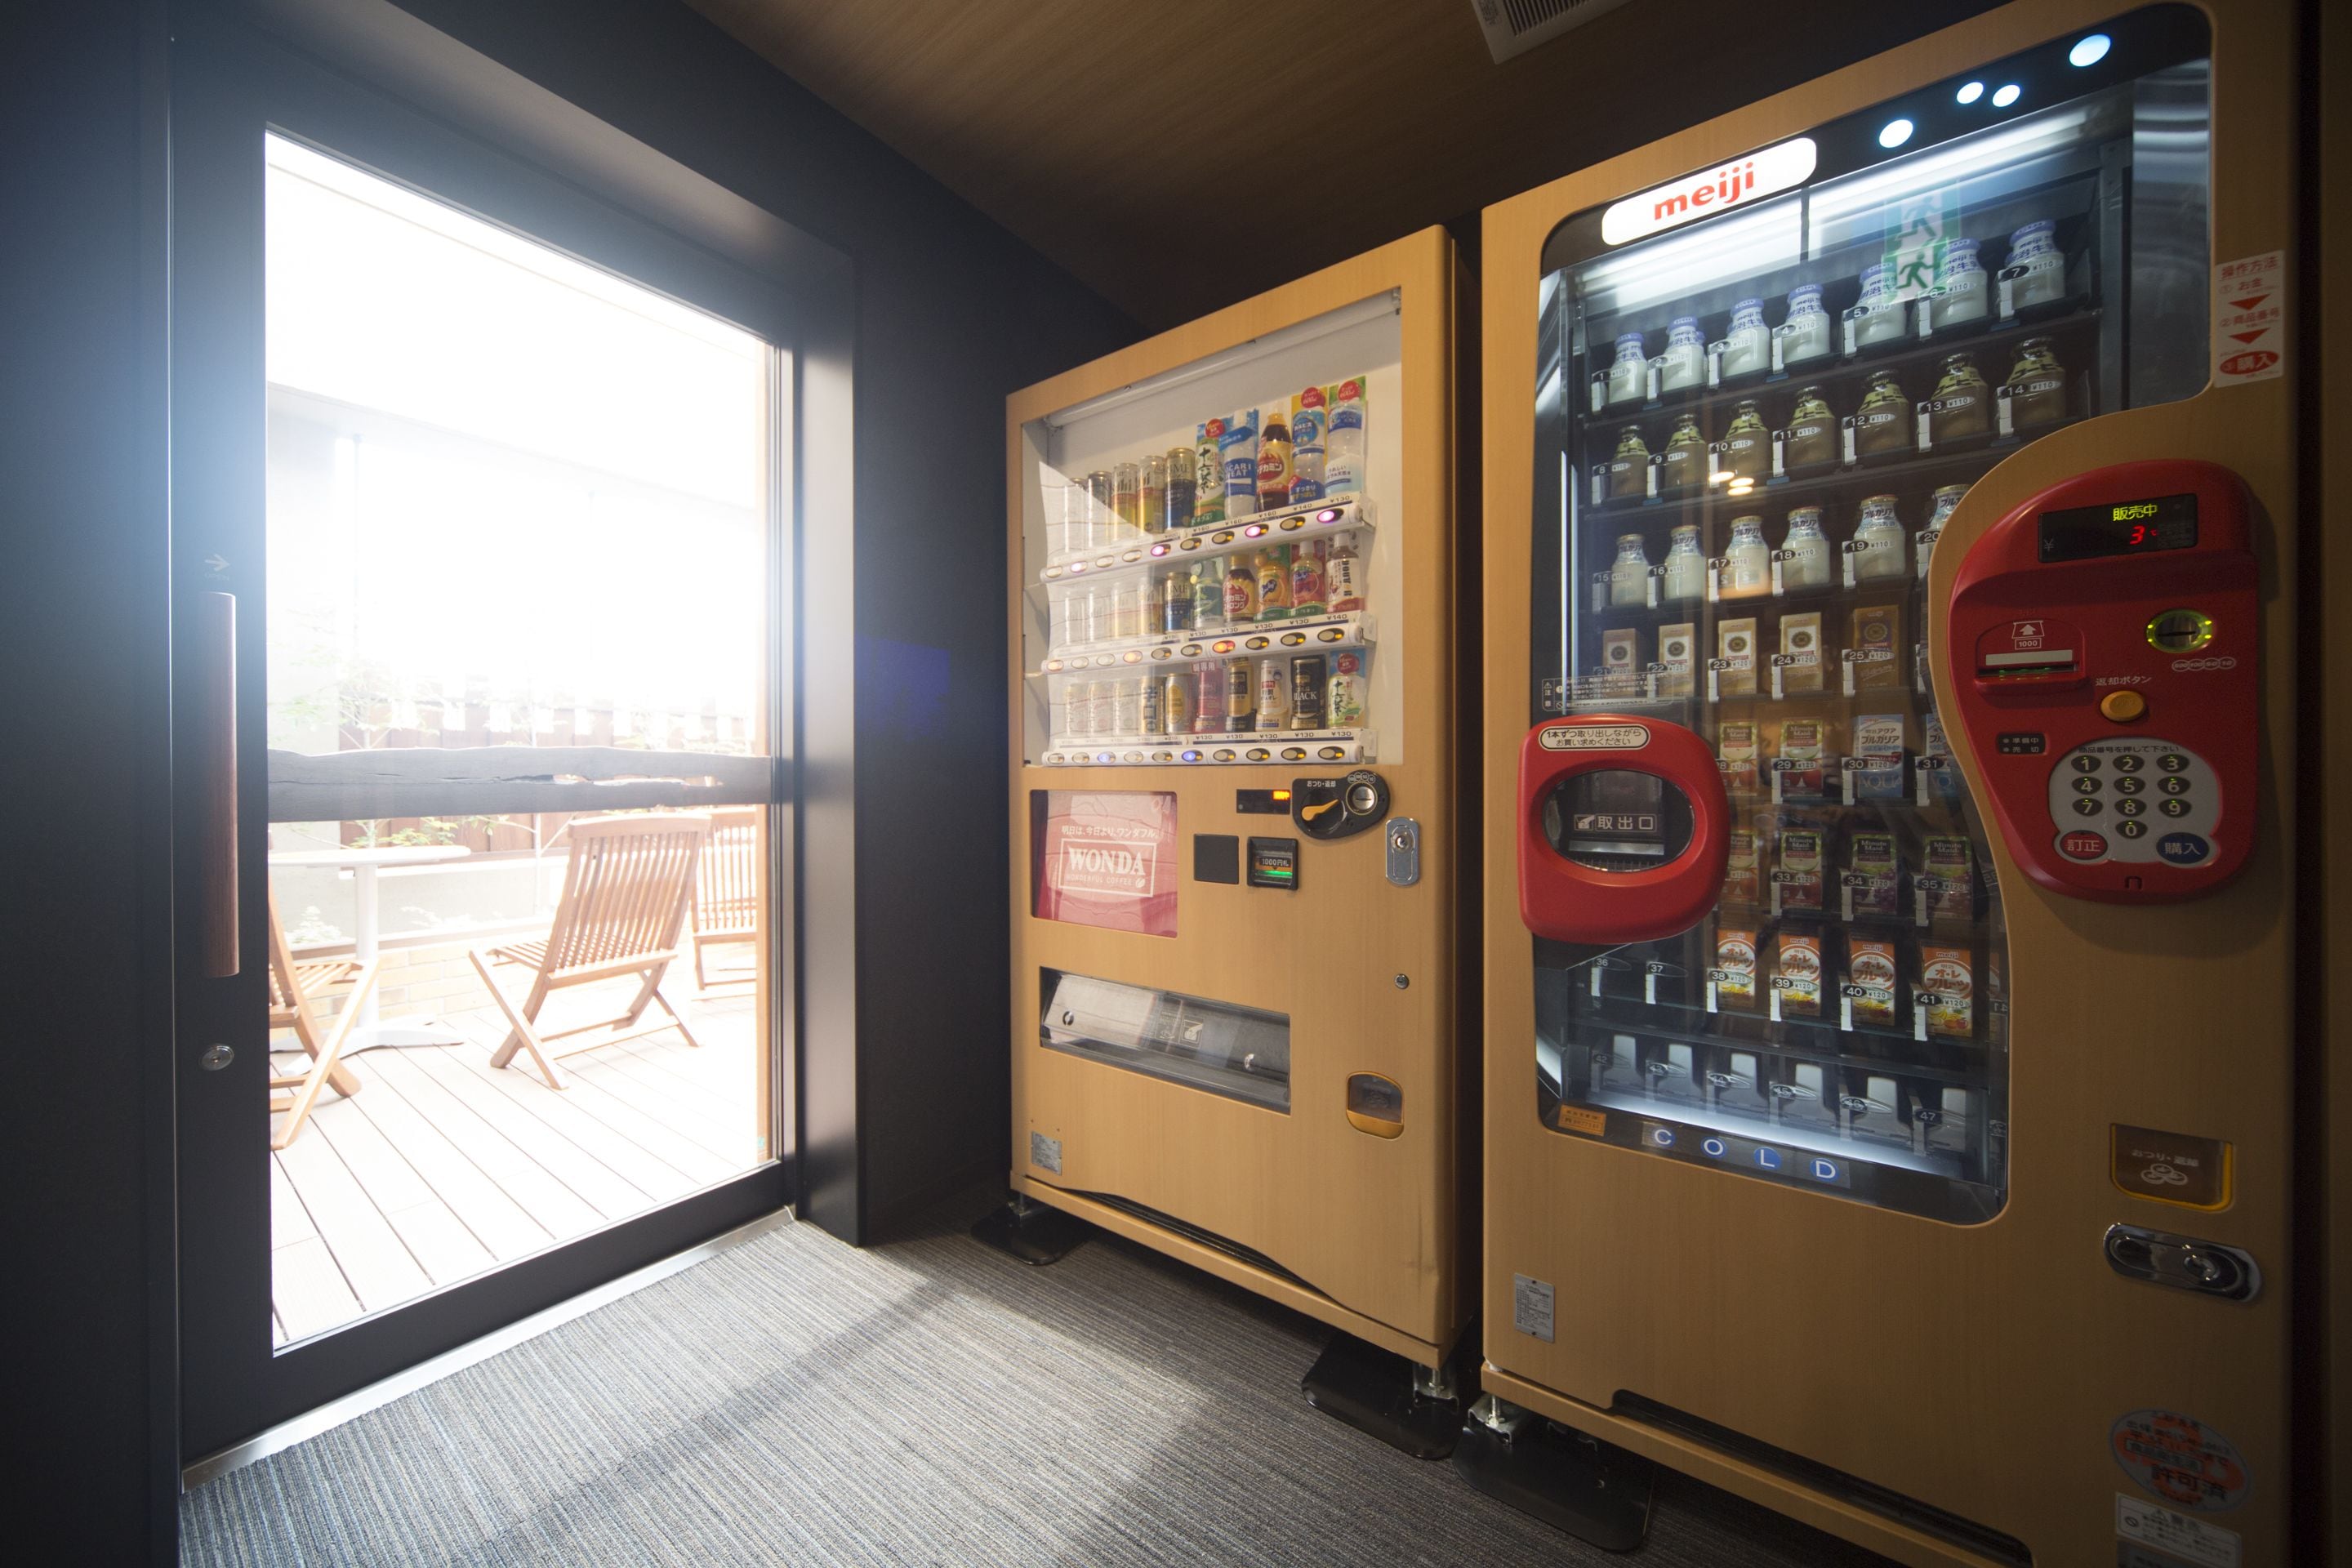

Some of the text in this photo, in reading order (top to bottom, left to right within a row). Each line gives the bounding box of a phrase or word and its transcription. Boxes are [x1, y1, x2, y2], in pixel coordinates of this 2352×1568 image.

[1654, 162, 1754, 220] meiji
[2012, 268, 2020, 278] 7
[1854, 308, 1862, 318] 5
[1781, 327, 1789, 336] 4
[1717, 343, 1725, 351] 3
[1655, 358, 1663, 367] 2
[2008, 385, 2025, 395] 14
[1927, 401, 1942, 412] 13
[1851, 416, 1865, 426] 12
[1780, 430, 1792, 439] 11
[1715, 443, 1728, 452] 10
[1655, 455, 1663, 464] 9
[1258, 463, 1282, 474] デカミン
[1864, 508, 1893, 519] ブルガリア
[2113, 503, 2158, 521] 販売中
[2130, 525, 2145, 545] 3
[1851, 542, 1864, 550] 19
[1779, 551, 1792, 559] 18
[1715, 559, 1727, 568] 17
[1653, 567, 1665, 575] 16
[1597, 573, 1609, 581] 15
[1850, 652, 1864, 660] 25
[1714, 660, 1727, 669] 23
[1778, 657, 1793, 665] 24
[2095, 675, 2153, 687] 返却ボタン
[1547, 728, 1642, 738] 1本ずつ取り出しながら
[1557, 737, 1632, 746] お買い求めください
[1861, 735, 1900, 744] ブルガリア
[2078, 745, 2180, 754] 商品番号を押して下さい
[1777, 760, 1792, 769] 29
[1848, 760, 1864, 769] 30
[1922, 760, 1937, 768] 31
[2081, 758, 2179, 771] 1 2 3
[1307, 780, 1337, 788] おつり・返却
[2081, 780, 2180, 792] 4 5 6
[2082, 802, 2180, 815] 7 8 9
[1597, 816, 1654, 830] 取出口
[2125, 824, 2136, 836] 0
[2067, 839, 2100, 852] 訂正
[2164, 842, 2201, 856] 購入
[1067, 844, 1146, 876] WONDA
[1262, 858, 1290, 866] 1000円札
[1106, 877, 1133, 886] COFFEE
[1776, 873, 1790, 881] 33
[1847, 876, 1863, 884] 34
[1921, 880, 1937, 889] 35
[1936, 951, 1959, 960] meiji
[1651, 964, 1664, 973] 37
[1712, 972, 1726, 980] 38
[1775, 979, 1790, 988] 39
[1846, 987, 1863, 996] 40
[1921, 995, 1935, 1004] 41
[1920, 1111, 1936, 1121] 47
[1655, 1129, 1836, 1178] COLD
